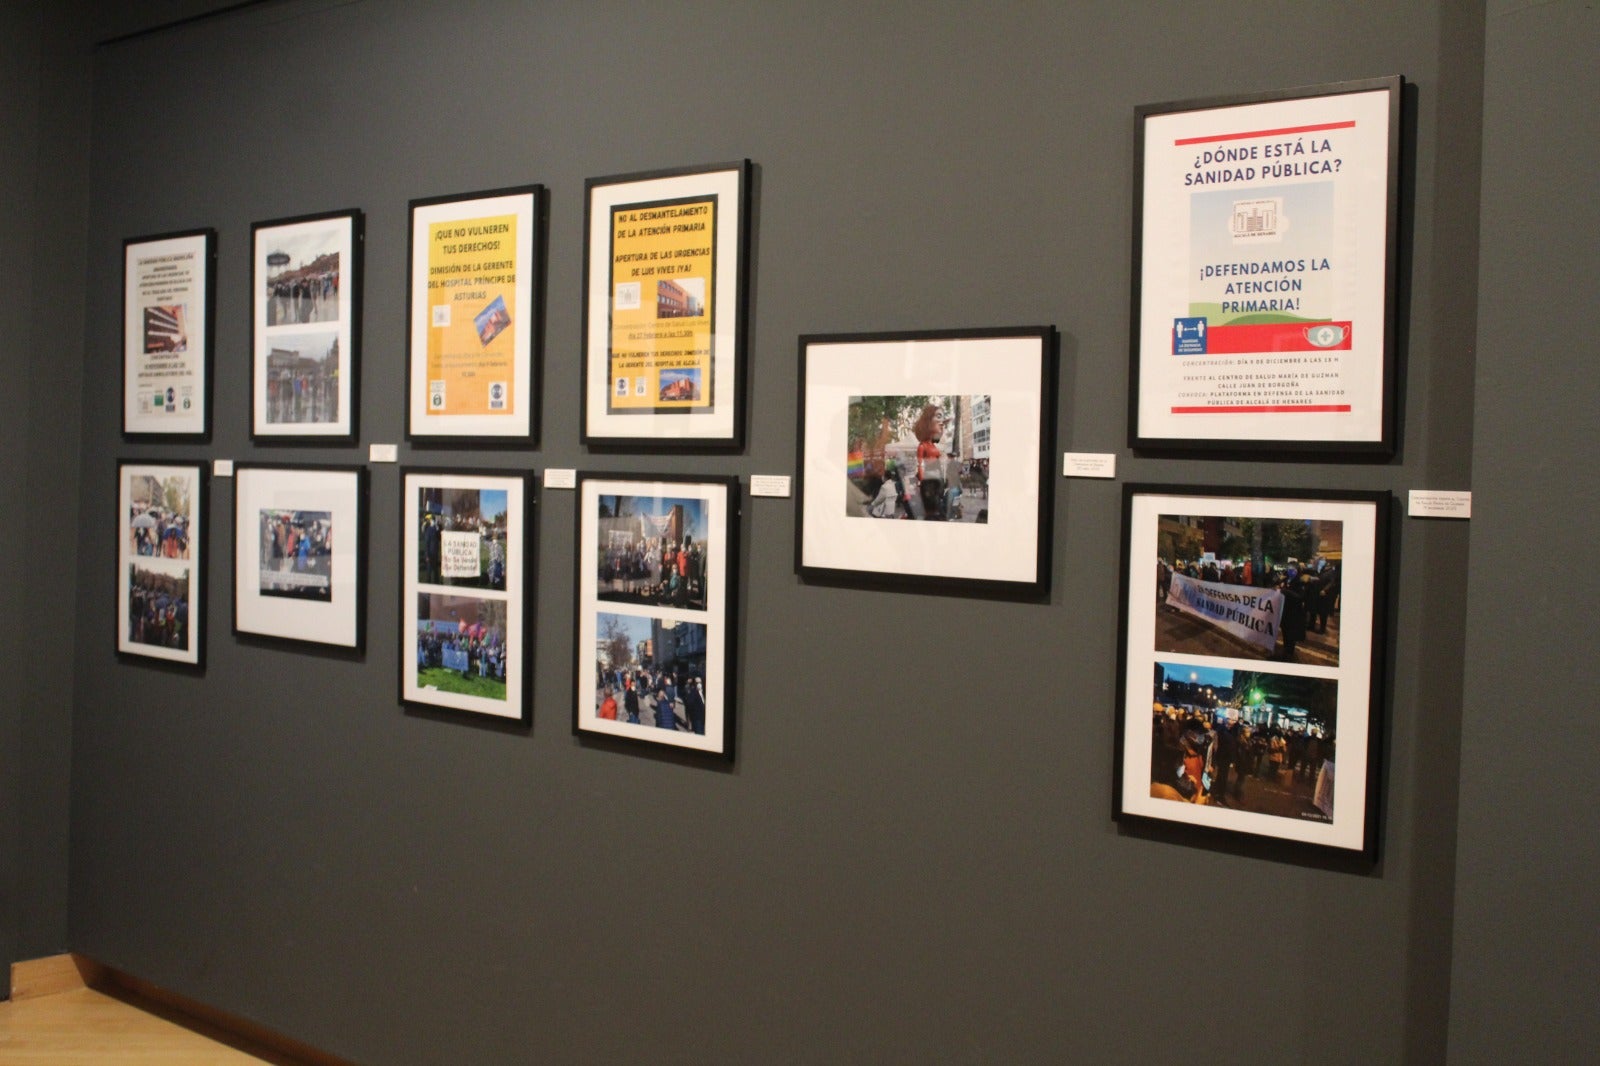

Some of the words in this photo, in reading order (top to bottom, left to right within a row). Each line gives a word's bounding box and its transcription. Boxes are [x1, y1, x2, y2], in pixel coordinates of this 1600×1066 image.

[1194, 146, 1258, 168] ¿DÓNDE
[1265, 138, 1304, 158] ESTÁ
[1311, 139, 1331, 153] LA
[1184, 168, 1255, 185] SANIDAD
[1262, 159, 1342, 179] PÚBLICA?
[618, 214, 627, 223] NO
[629, 213, 637, 222] AL
[640, 206, 708, 221] DESMANTELAMIENTO
[454, 228, 466, 238] NO
[467, 224, 509, 236] VULNEREN
[618, 230, 625, 239] DE
[628, 229, 636, 237] LA
[638, 224, 670, 236] ATENCIÓN
[673, 223, 705, 234] PRIMARIA
[443, 244, 457, 254] TUS
[458, 241, 501, 253] DERECHOS!
[615, 252, 648, 263] APERTURA
[650, 252, 658, 260] DE
[660, 251, 672, 259] LAS
[674, 247, 710, 258] URGENCIAS
[430, 262, 461, 275] DIMISIÓN
[462, 264, 471, 272] DE
[473, 263, 481, 271] LA
[483, 261, 513, 271] GERENTE
[631, 268, 640, 277] DE
[641, 267, 654, 275] LUIS
[657, 266, 675, 274] VIVES
[1200, 259, 1305, 280] ¡DEFENDAMOS
[1311, 258, 1330, 271] LA
[441, 279, 472, 288] HOSPITAL
[474, 275, 505, 285] PRÍNCIPE
[507, 274, 516, 283] DE
[1225, 277, 1302, 294] ATENCIÓN
[453, 291, 487, 301] ASTURIAS
[1222, 298, 1300, 313] PRIMARIA!
[1242, 595, 1257, 608] DE
[1258, 598, 1274, 613] LA
[1226, 607, 1274, 637] PÚBLICA
